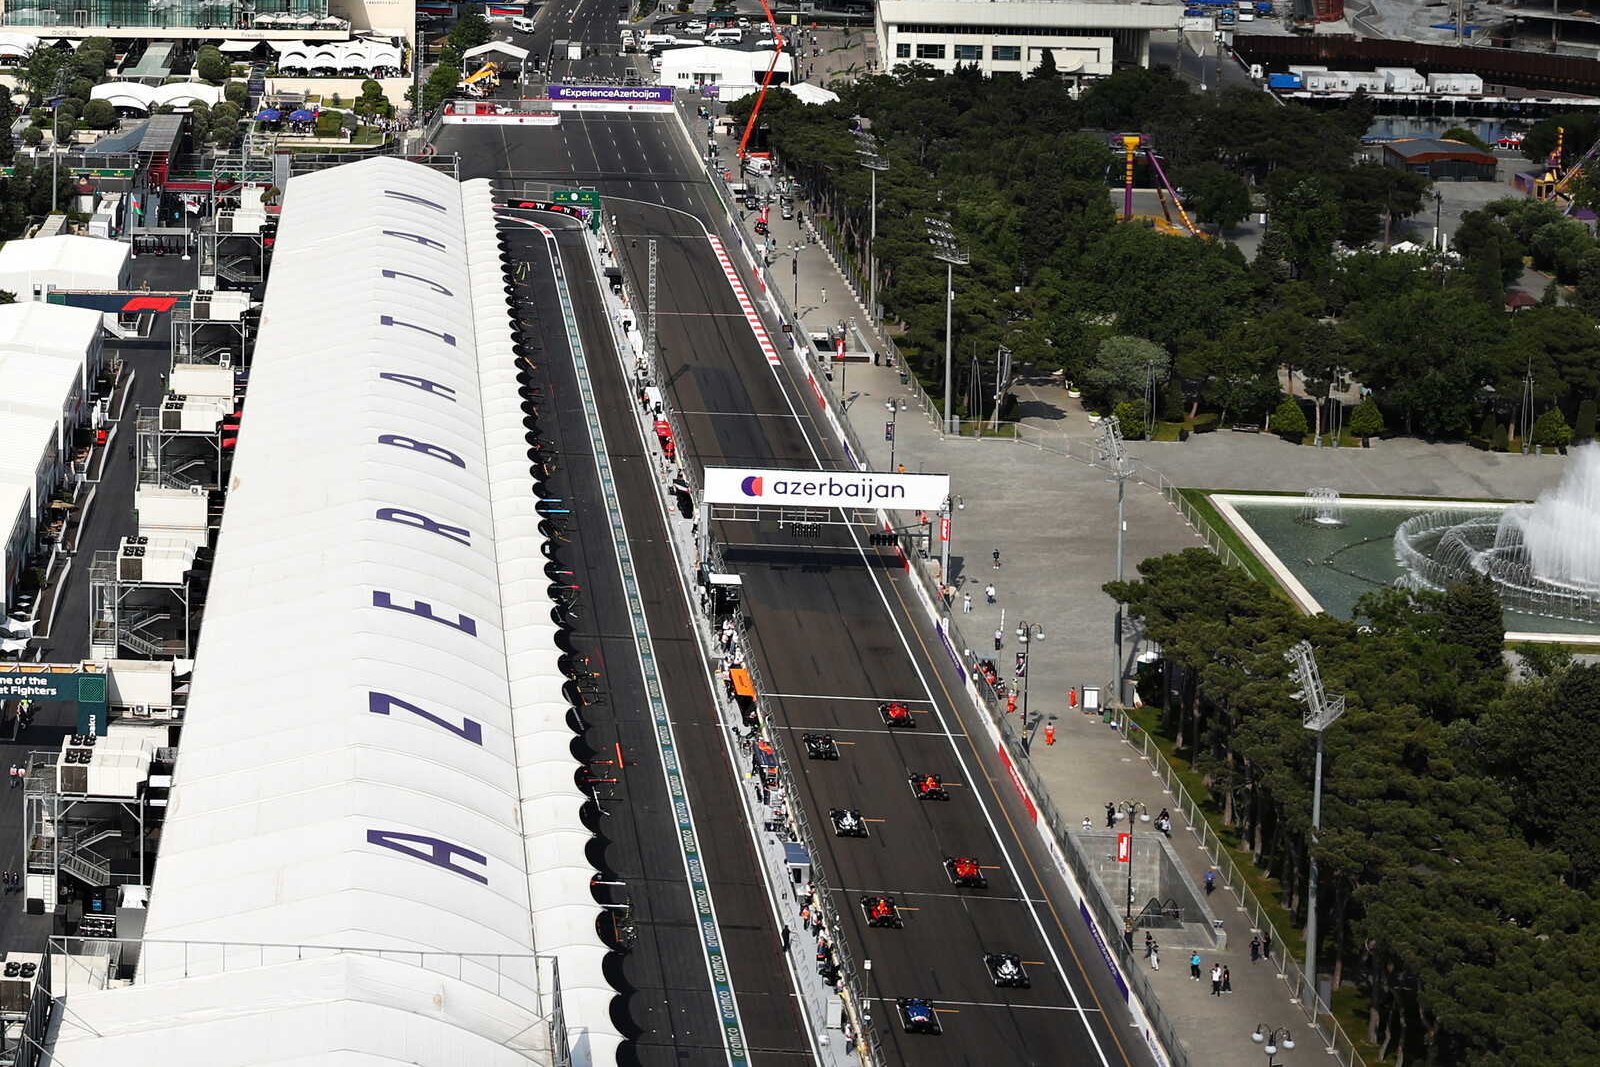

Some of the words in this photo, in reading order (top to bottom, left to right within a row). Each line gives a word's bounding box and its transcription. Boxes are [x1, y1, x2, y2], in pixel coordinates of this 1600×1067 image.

[559, 89, 661, 99] #ExperienceAzerbaijan
[773, 477, 905, 503] azerbaijan
[367, 190, 488, 885] AZERBAIJAN
[14, 676, 27, 685] of
[28, 676, 47, 685] the
[689, 859, 703, 883] aramco
[696, 889, 710, 914] aramco
[703, 921, 718, 947] aramco
[711, 955, 726, 982] aramco
[719, 990, 735, 1019] aramco
[727, 1027, 744, 1057] aramco
